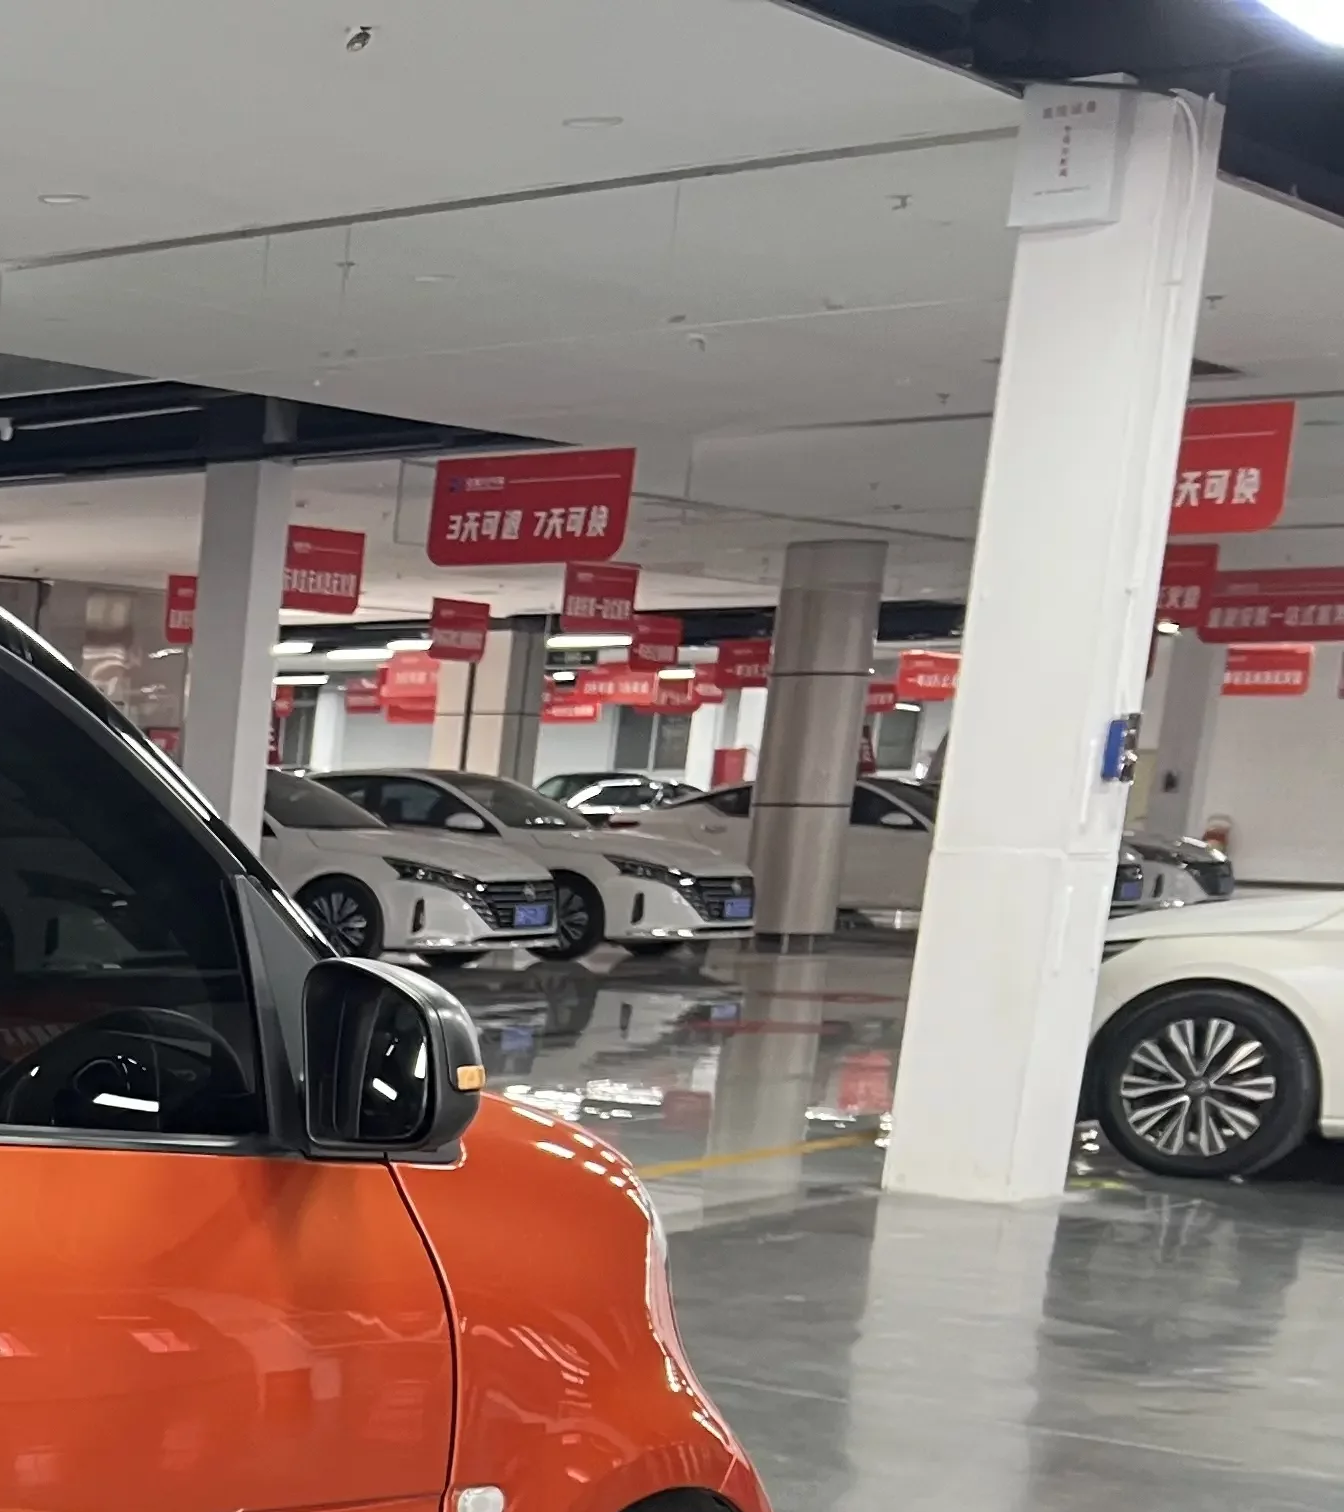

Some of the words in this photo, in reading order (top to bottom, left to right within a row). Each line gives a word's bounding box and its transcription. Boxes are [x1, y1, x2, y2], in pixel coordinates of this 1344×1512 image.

[445, 509, 523, 542] 3天可退
[532, 504, 609, 539] 7天可换
